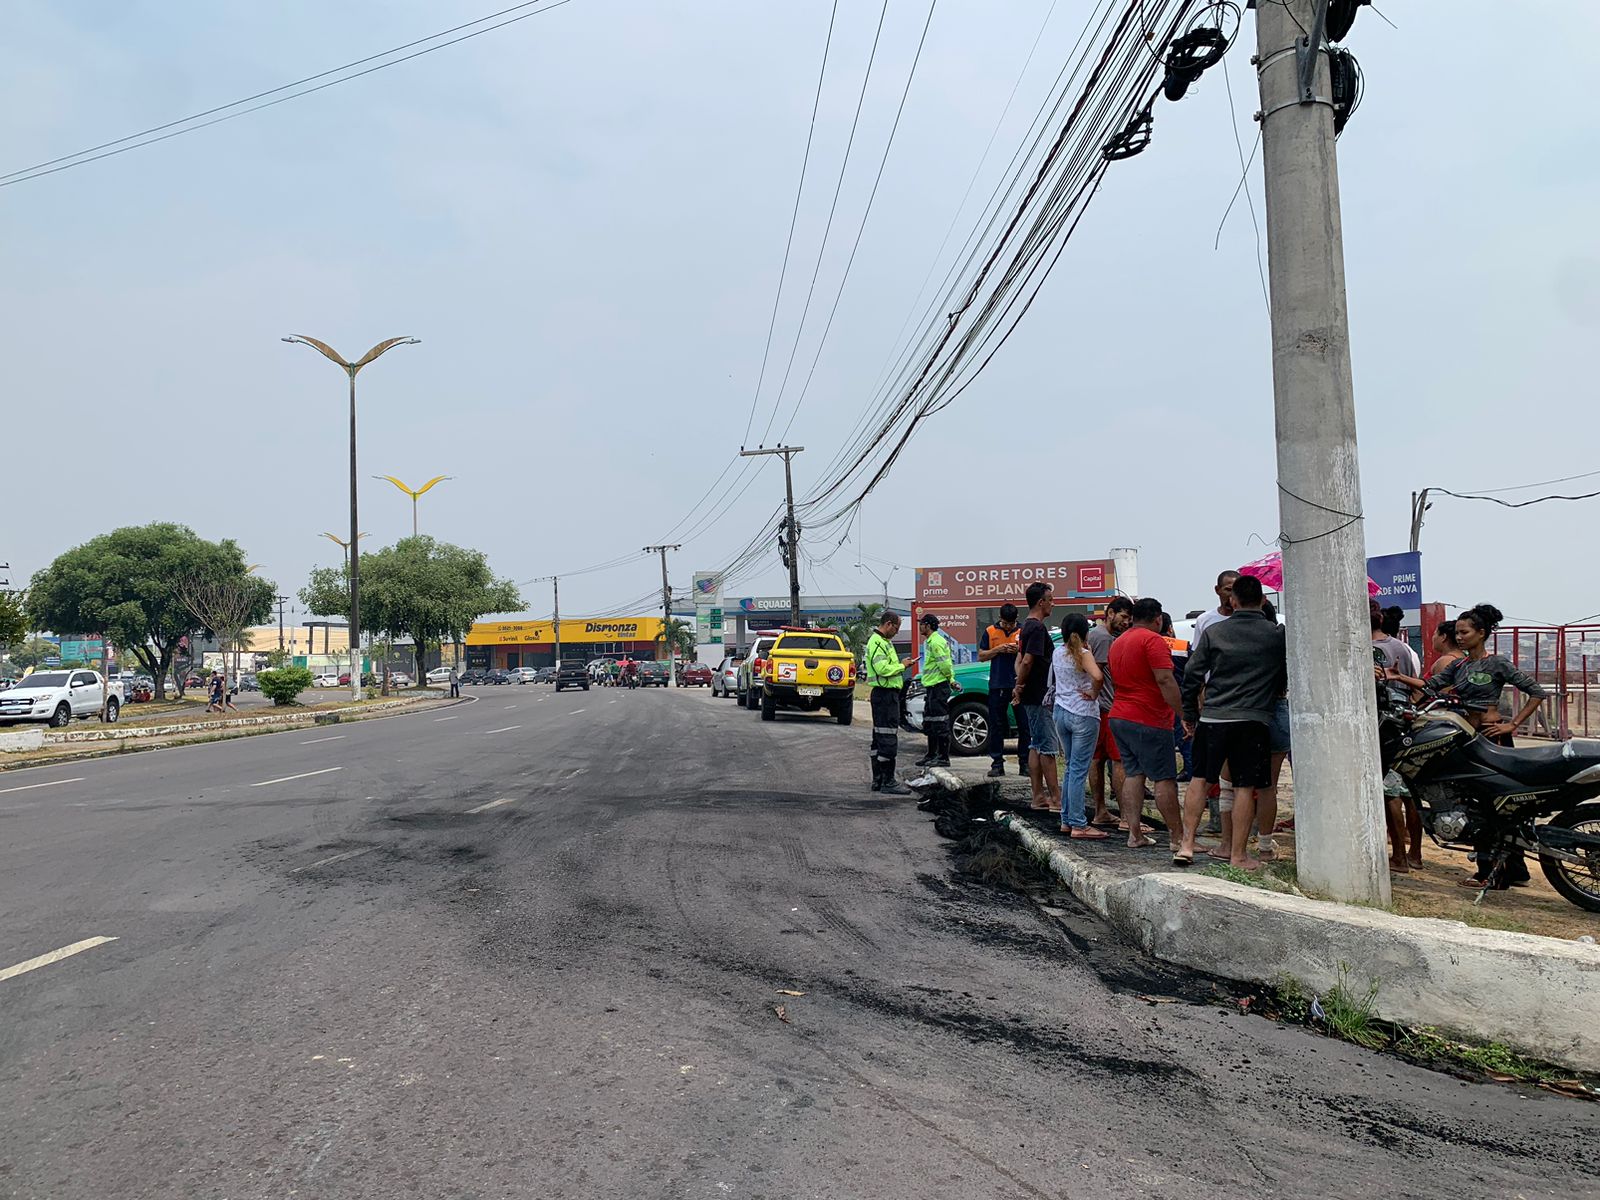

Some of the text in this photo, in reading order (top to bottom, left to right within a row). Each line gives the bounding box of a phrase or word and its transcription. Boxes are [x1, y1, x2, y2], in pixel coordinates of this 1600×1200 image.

[955, 567, 1067, 582] CORRETORES
[1392, 574, 1416, 583] PRIME
[923, 588, 949, 598] prime
[965, 580, 1055, 596] DE PLANTO
[1377, 585, 1417, 596] ADE NOVA
[758, 600, 791, 610] EQUADO
[585, 622, 638, 633] Dismonza
[1511, 793, 1538, 803] YAMAHA
